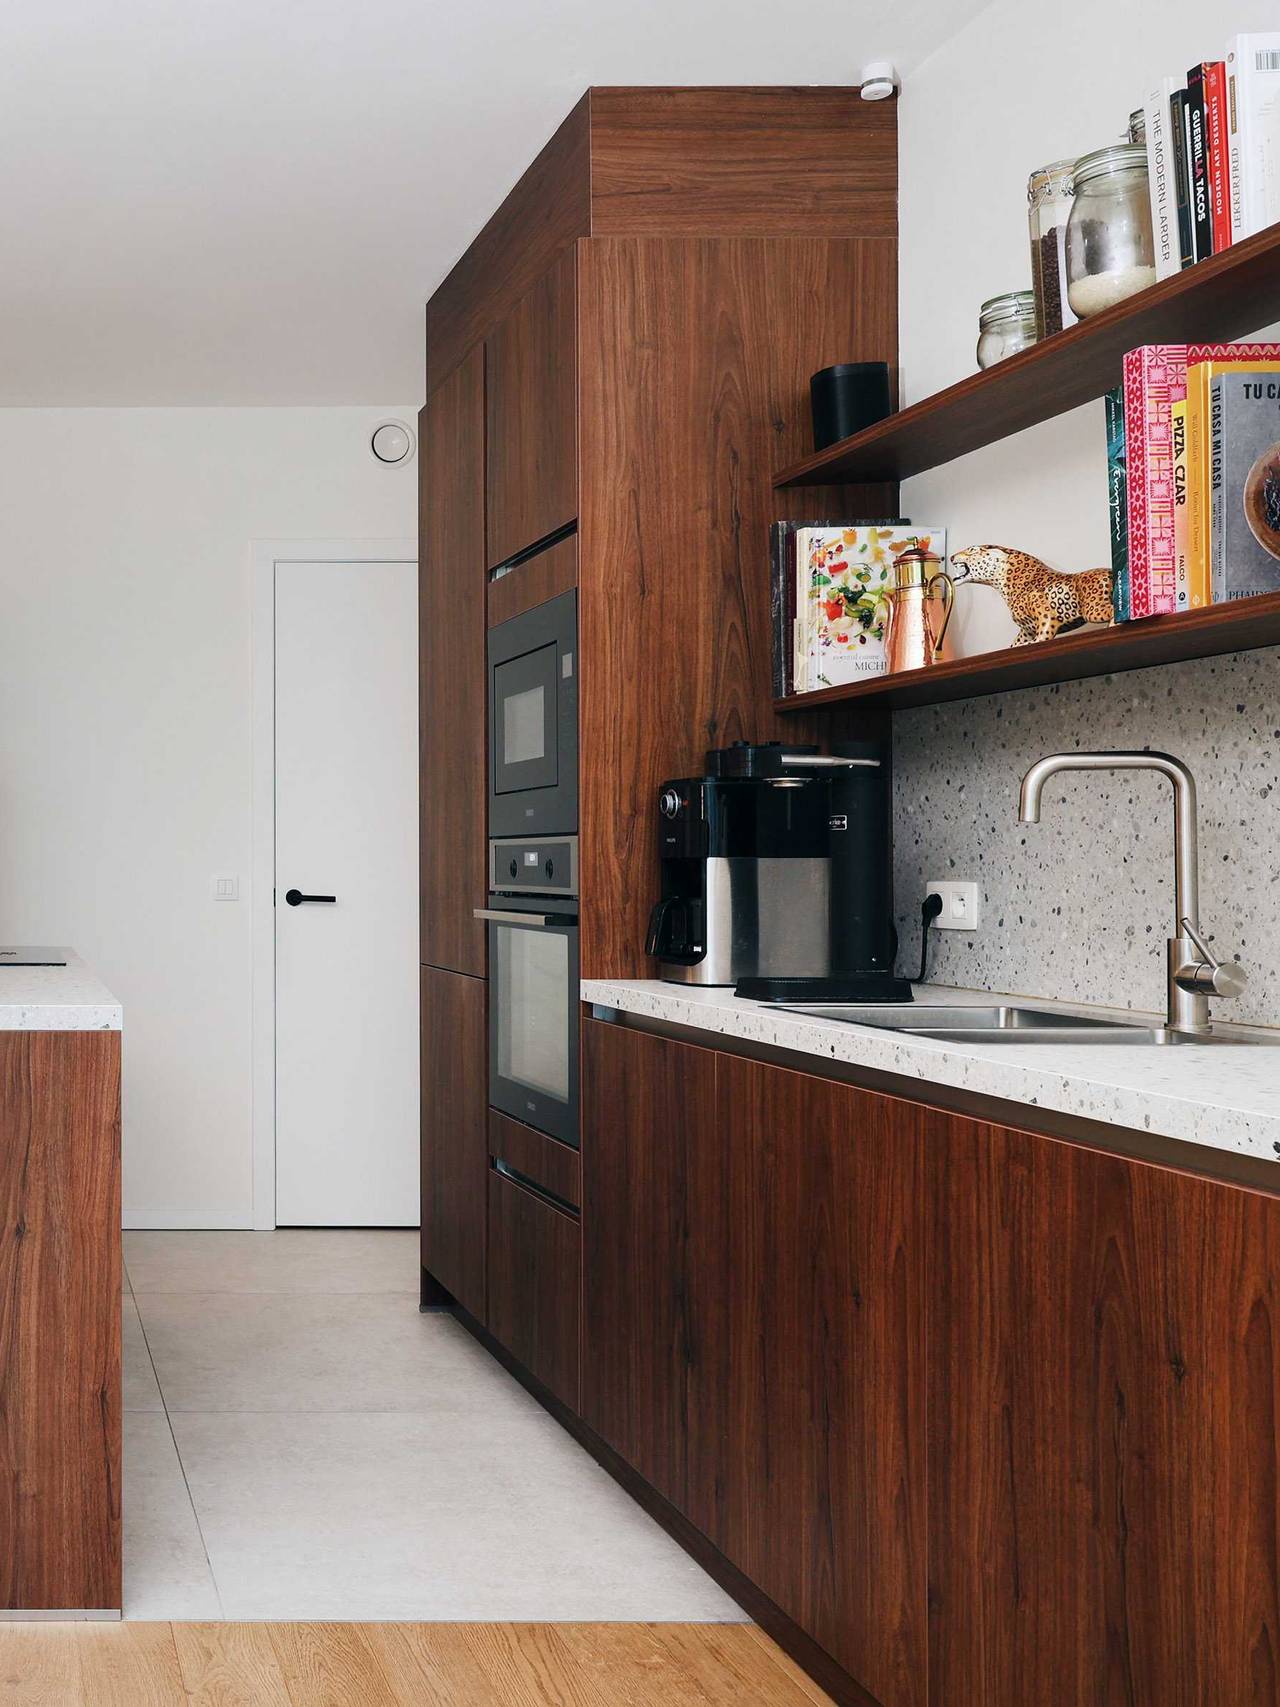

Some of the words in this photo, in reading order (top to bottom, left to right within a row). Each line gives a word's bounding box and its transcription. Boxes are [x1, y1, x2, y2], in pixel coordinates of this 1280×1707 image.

[1152, 109, 1163, 138] THE
[1211, 96, 1220, 145] DESSERTS
[1192, 109, 1204, 178] GUERRILLA
[1154, 142, 1168, 203] MODERN
[1195, 178, 1206, 222] TACOS
[1159, 206, 1171, 262] LARDER
[1212, 385, 1221, 402] TU
[1243, 383, 1263, 400] TU
[1174, 415, 1185, 461] PIZZA
[1212, 404, 1222, 437] CASA
[1213, 439, 1222, 455] MI
[1175, 464, 1186, 506] CZAR
[1213, 459, 1222, 490] CASA
[855, 661, 888, 671] MICH
